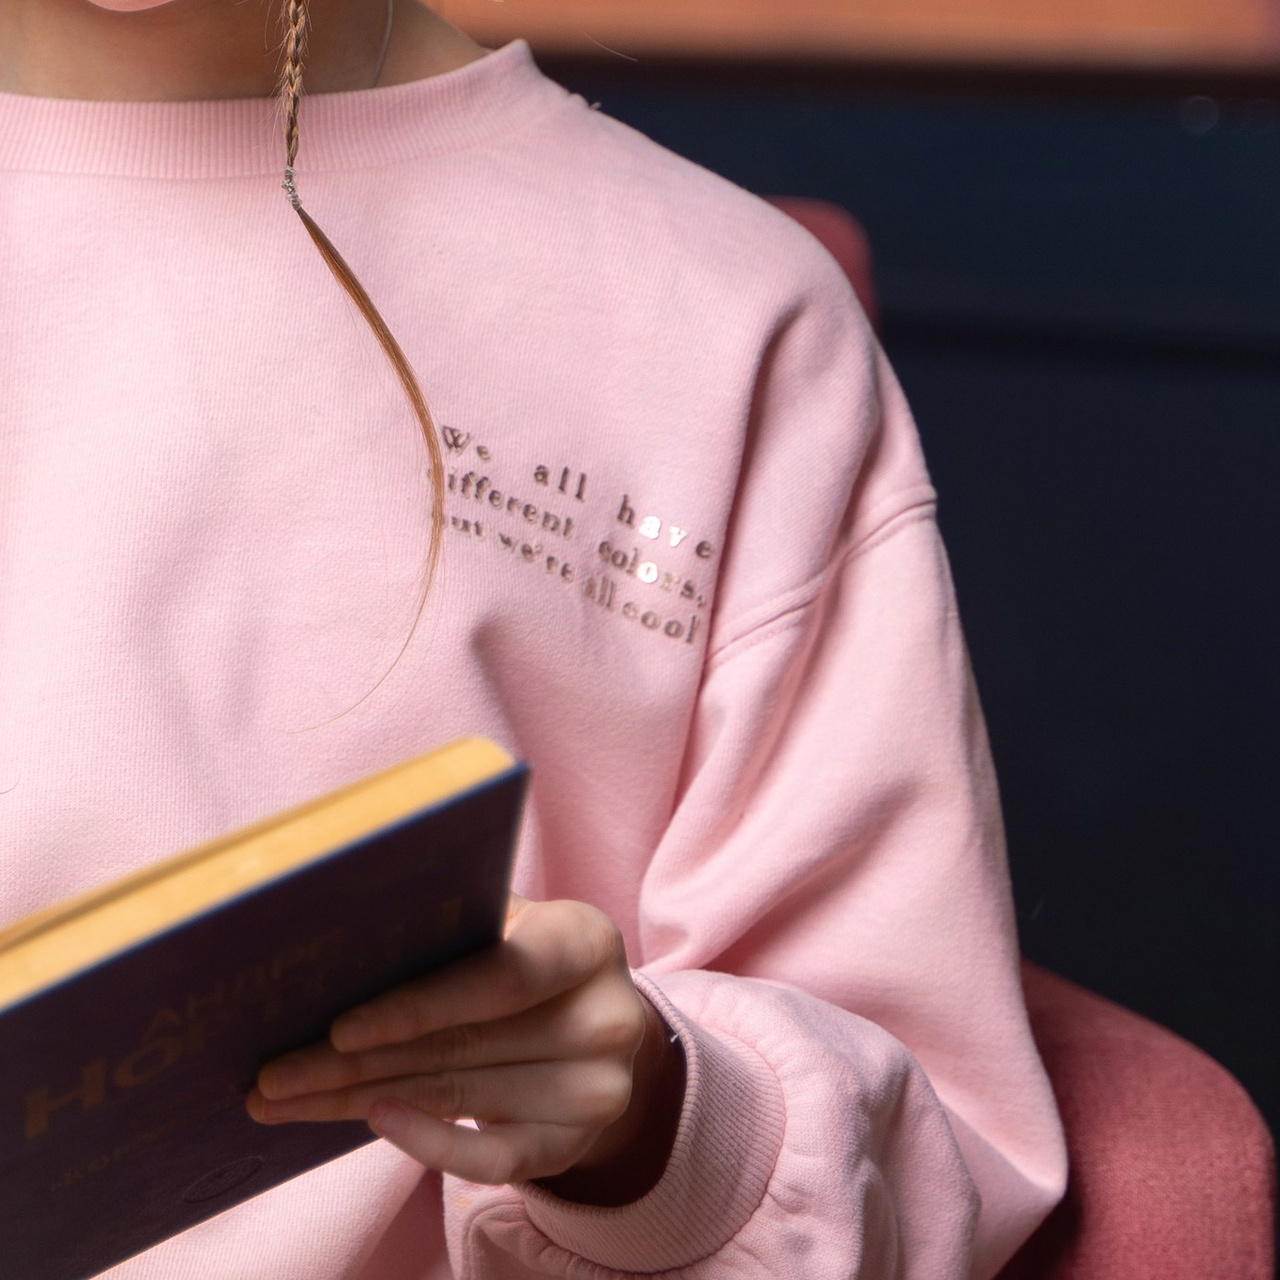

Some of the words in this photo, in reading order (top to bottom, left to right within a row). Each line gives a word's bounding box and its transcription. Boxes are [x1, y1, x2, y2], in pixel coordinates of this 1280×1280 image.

[428, 467, 573, 538] ifferent
[442, 425, 491, 461] We
[534, 465, 587, 502] all
[617, 494, 714, 559] have
[622, 601, 699, 643] cool
